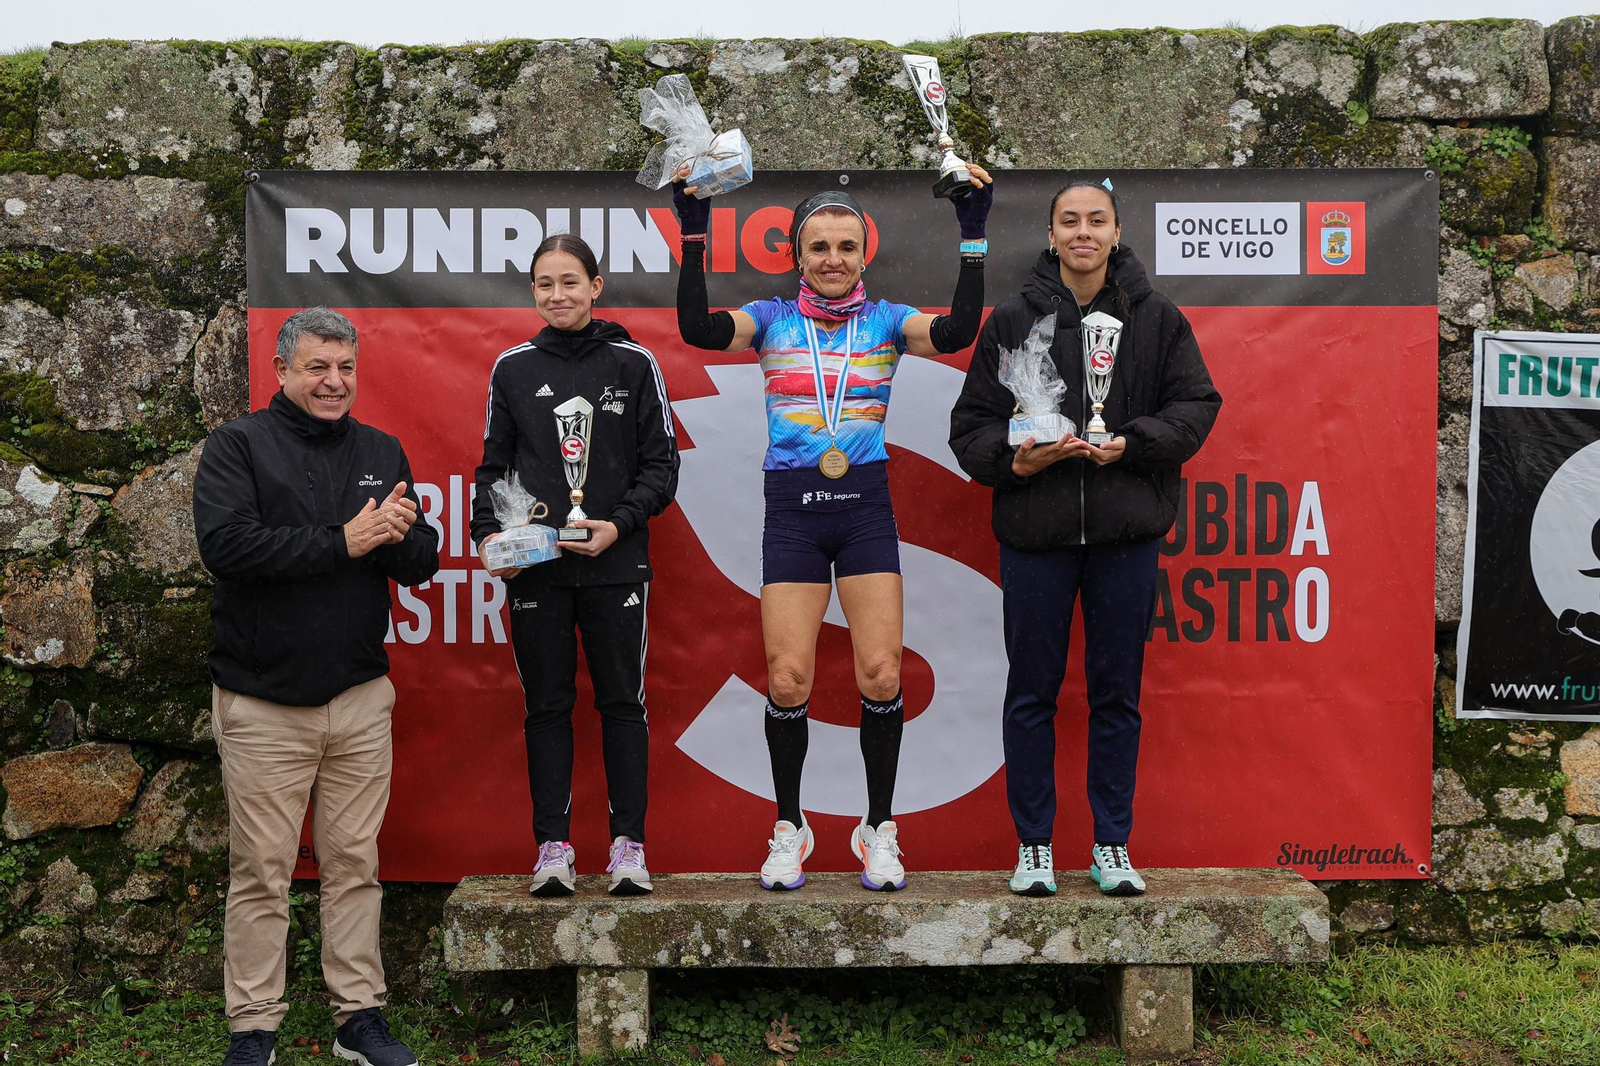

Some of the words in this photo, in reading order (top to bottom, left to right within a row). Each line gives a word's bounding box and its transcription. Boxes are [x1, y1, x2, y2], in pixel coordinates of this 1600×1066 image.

[1167, 218, 1288, 236] CONCELLO
[1182, 241, 1211, 258] DE
[1219, 241, 1274, 258] VIGO
[1498, 353, 1600, 398] FRUT
[833, 493, 861, 501] seguros
